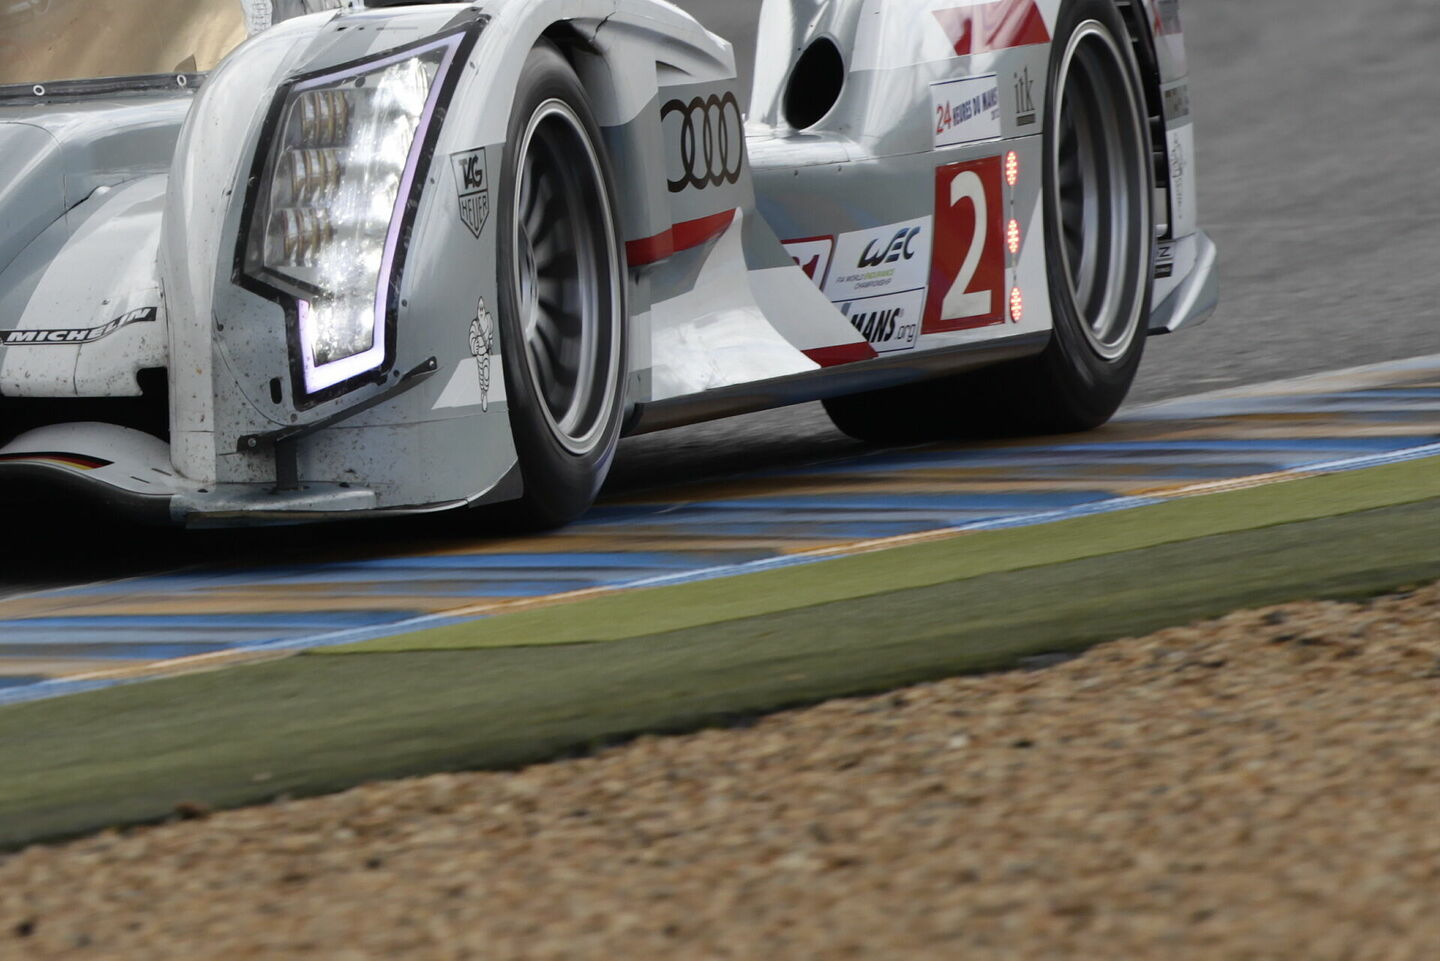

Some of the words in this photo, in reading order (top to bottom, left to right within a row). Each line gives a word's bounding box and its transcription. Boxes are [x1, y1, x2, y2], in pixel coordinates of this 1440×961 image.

[936, 100, 951, 134] 24
[458, 154, 483, 190] TAG
[461, 195, 488, 232] HEUER
[857, 226, 921, 268] WEC
[939, 169, 994, 322] 2
[6, 306, 151, 344] MICHELIN
